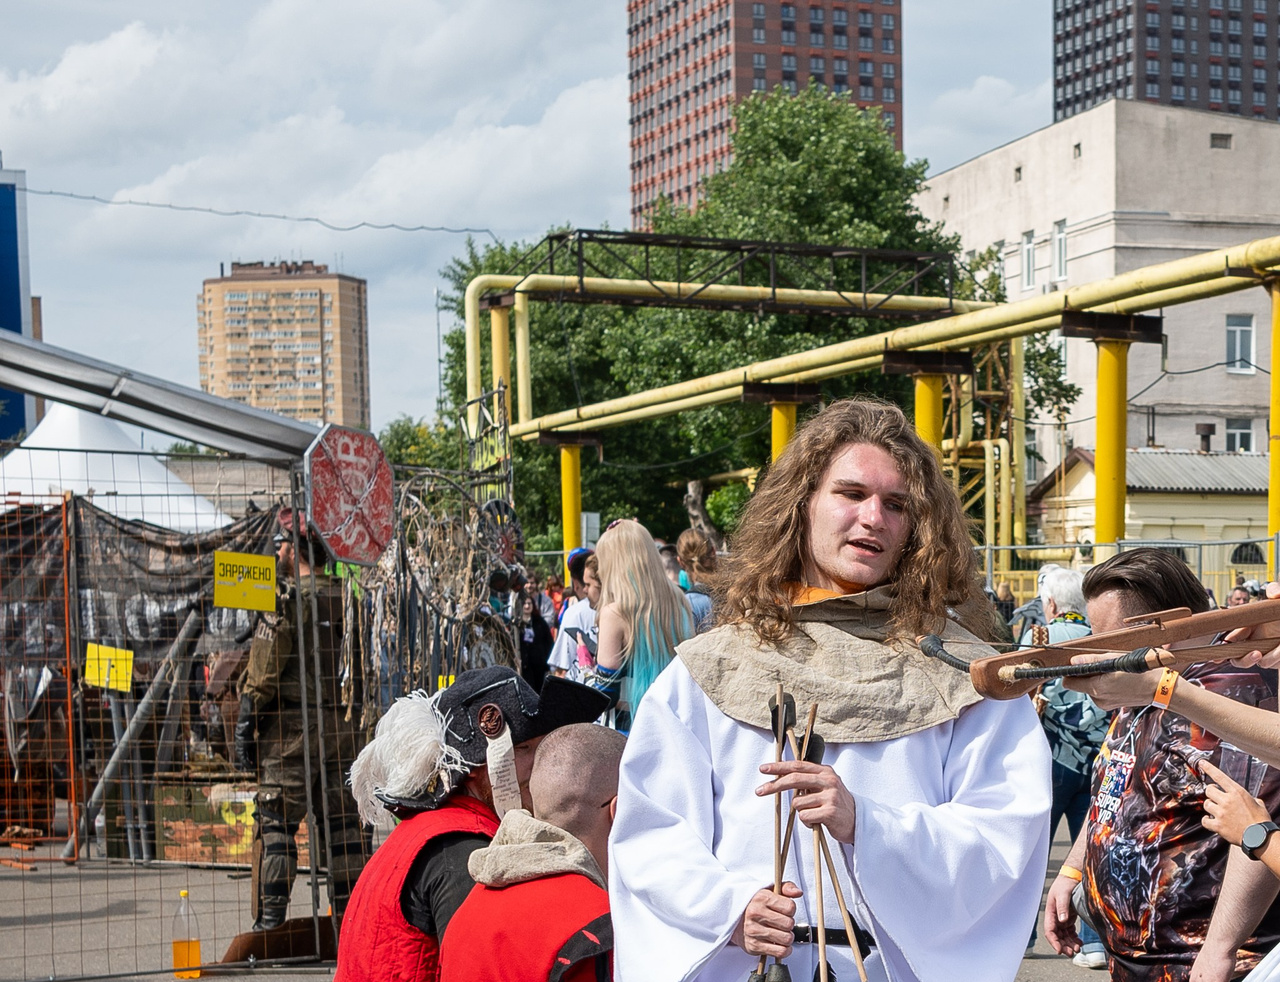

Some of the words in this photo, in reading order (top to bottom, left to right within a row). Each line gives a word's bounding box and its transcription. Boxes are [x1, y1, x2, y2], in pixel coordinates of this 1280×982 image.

[337, 436, 370, 550] STOP
[219, 562, 272, 581] ЗАРАЖЕНО
[1095, 792, 1122, 814] SUPER
[1097, 808, 1112, 824] VIP
